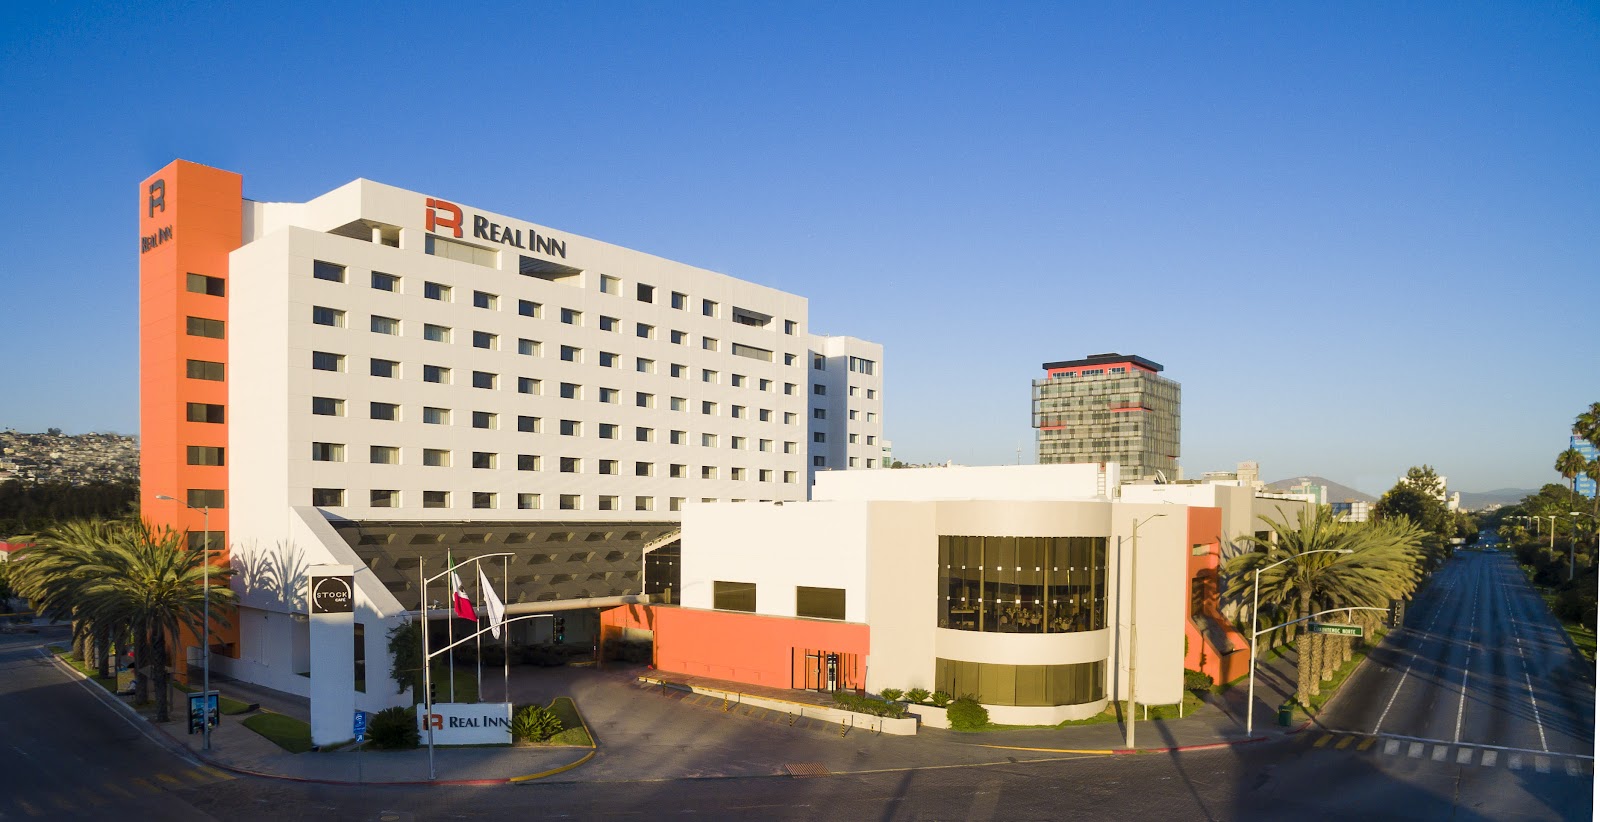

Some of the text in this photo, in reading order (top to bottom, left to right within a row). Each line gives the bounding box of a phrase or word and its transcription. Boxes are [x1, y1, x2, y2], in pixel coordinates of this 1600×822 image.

[141, 224, 173, 254] REAL INN
[473, 214, 566, 259] REAL INN
[449, 716, 509, 728] REAL INN
